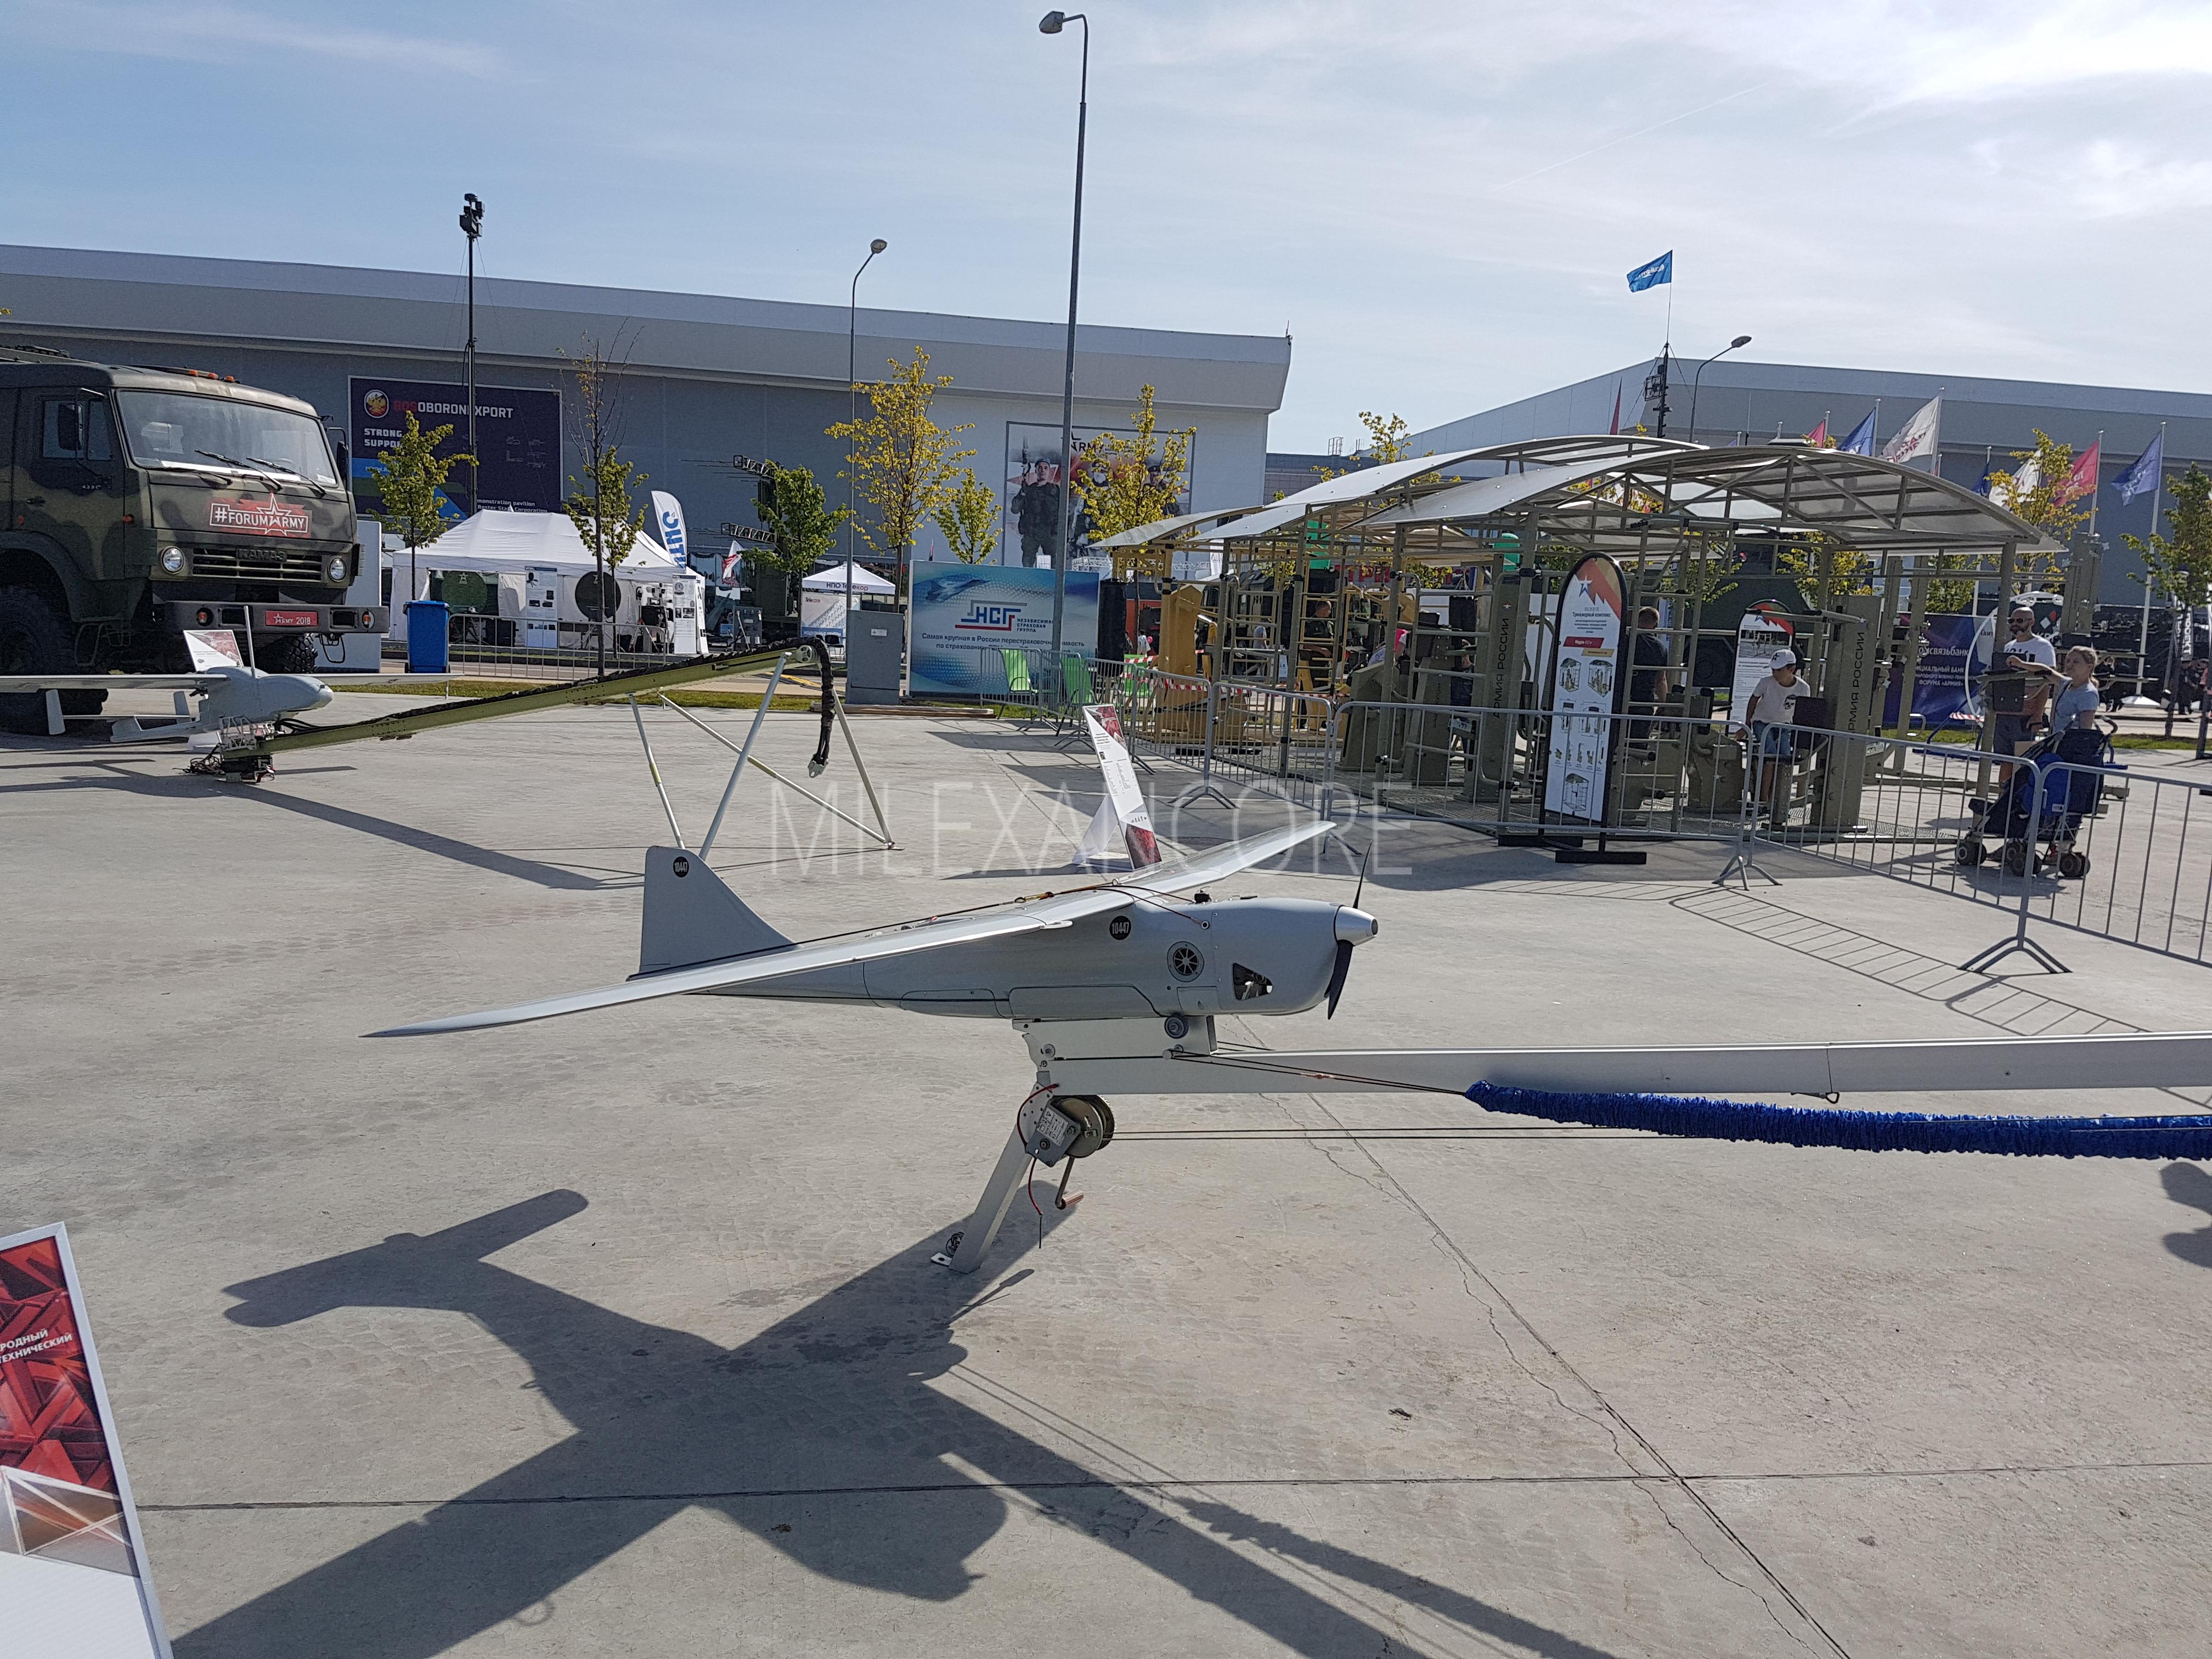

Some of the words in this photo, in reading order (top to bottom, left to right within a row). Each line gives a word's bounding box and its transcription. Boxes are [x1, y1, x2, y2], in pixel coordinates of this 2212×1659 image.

[364, 428, 402, 438] STRONG
[296, 617, 311, 625] 2018
[961, 606, 1021, 625] НСГ
[1001, 637, 1053, 646] перестраховочн
[1497, 618, 1509, 670] РОССИИ
[1853, 632, 1865, 687] РОССИИ
[1111, 922, 1130, 934] 10447
